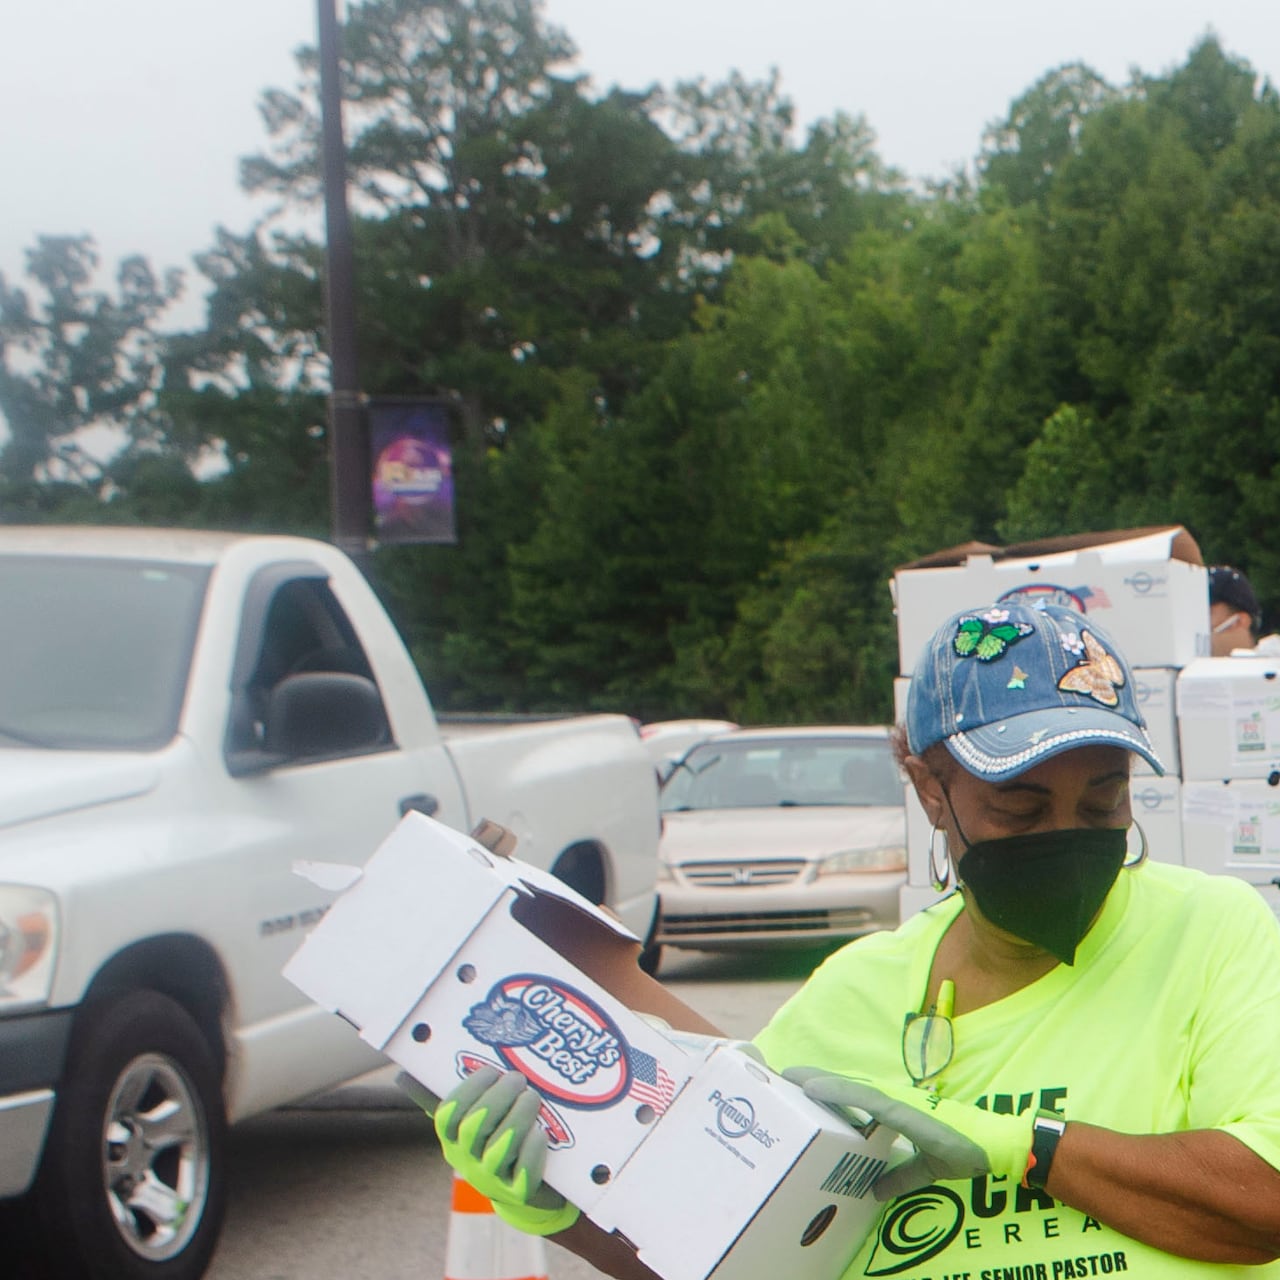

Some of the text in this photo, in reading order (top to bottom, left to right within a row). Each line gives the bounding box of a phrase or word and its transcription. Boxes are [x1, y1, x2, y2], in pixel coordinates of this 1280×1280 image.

[519, 983, 623, 1069] Cheryl's
[530, 1028, 598, 1086] Best
[706, 1088, 778, 1150] PrimusLabs
